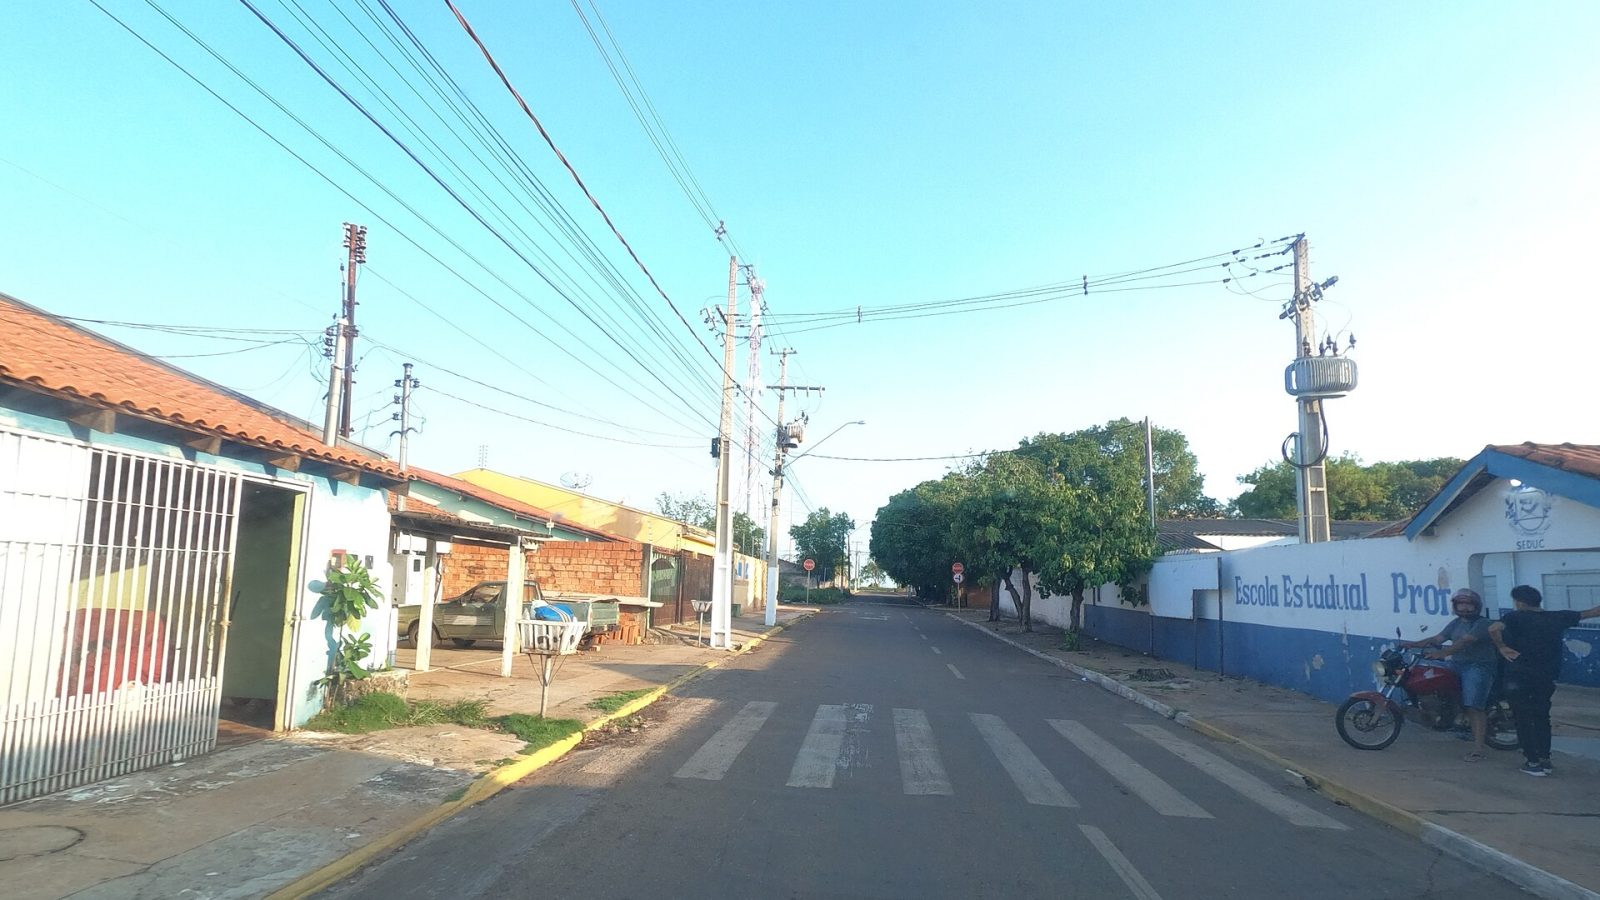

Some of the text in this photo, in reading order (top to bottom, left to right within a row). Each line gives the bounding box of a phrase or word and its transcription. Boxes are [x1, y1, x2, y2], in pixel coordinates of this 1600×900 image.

[1516, 538, 1545, 550] SEDUC
[1234, 575, 1279, 607] Escola
[1281, 573, 1370, 611] Estadual
